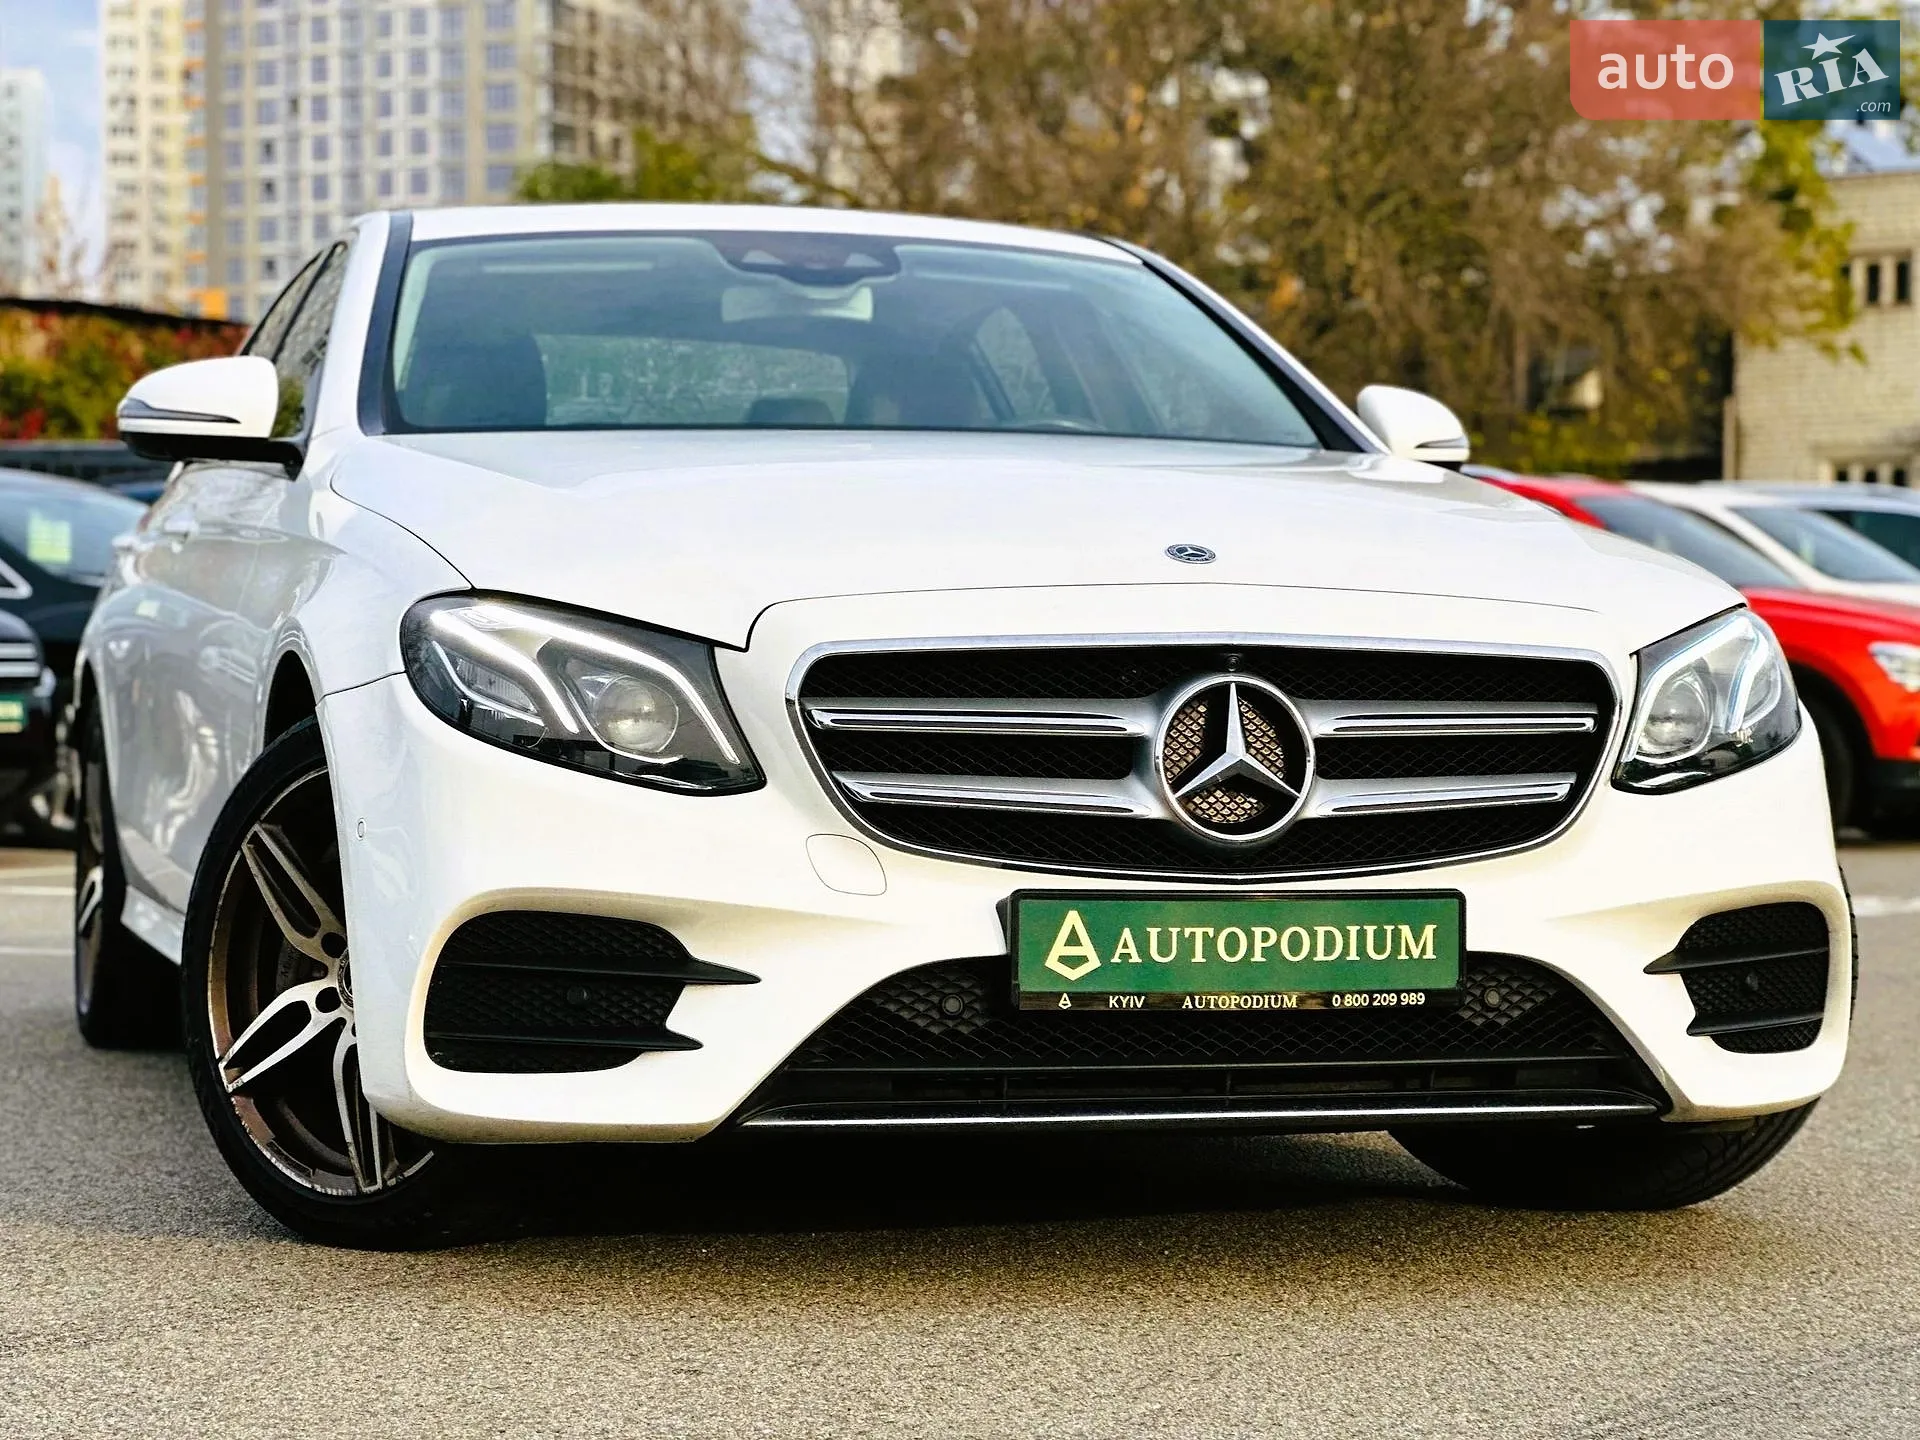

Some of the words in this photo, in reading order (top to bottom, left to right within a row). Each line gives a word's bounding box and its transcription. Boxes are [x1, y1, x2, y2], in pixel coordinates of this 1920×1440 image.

[1111, 924, 1437, 964] AUTOPODIUM
[1109, 995, 1145, 1009] KYIV
[1182, 994, 1298, 1009] AUTOPODIUM
[1332, 994, 1341, 1007] 0
[1343, 994, 1369, 1007] 800
[1372, 993, 1398, 1006] 209
[1400, 992, 1426, 1006] 989
